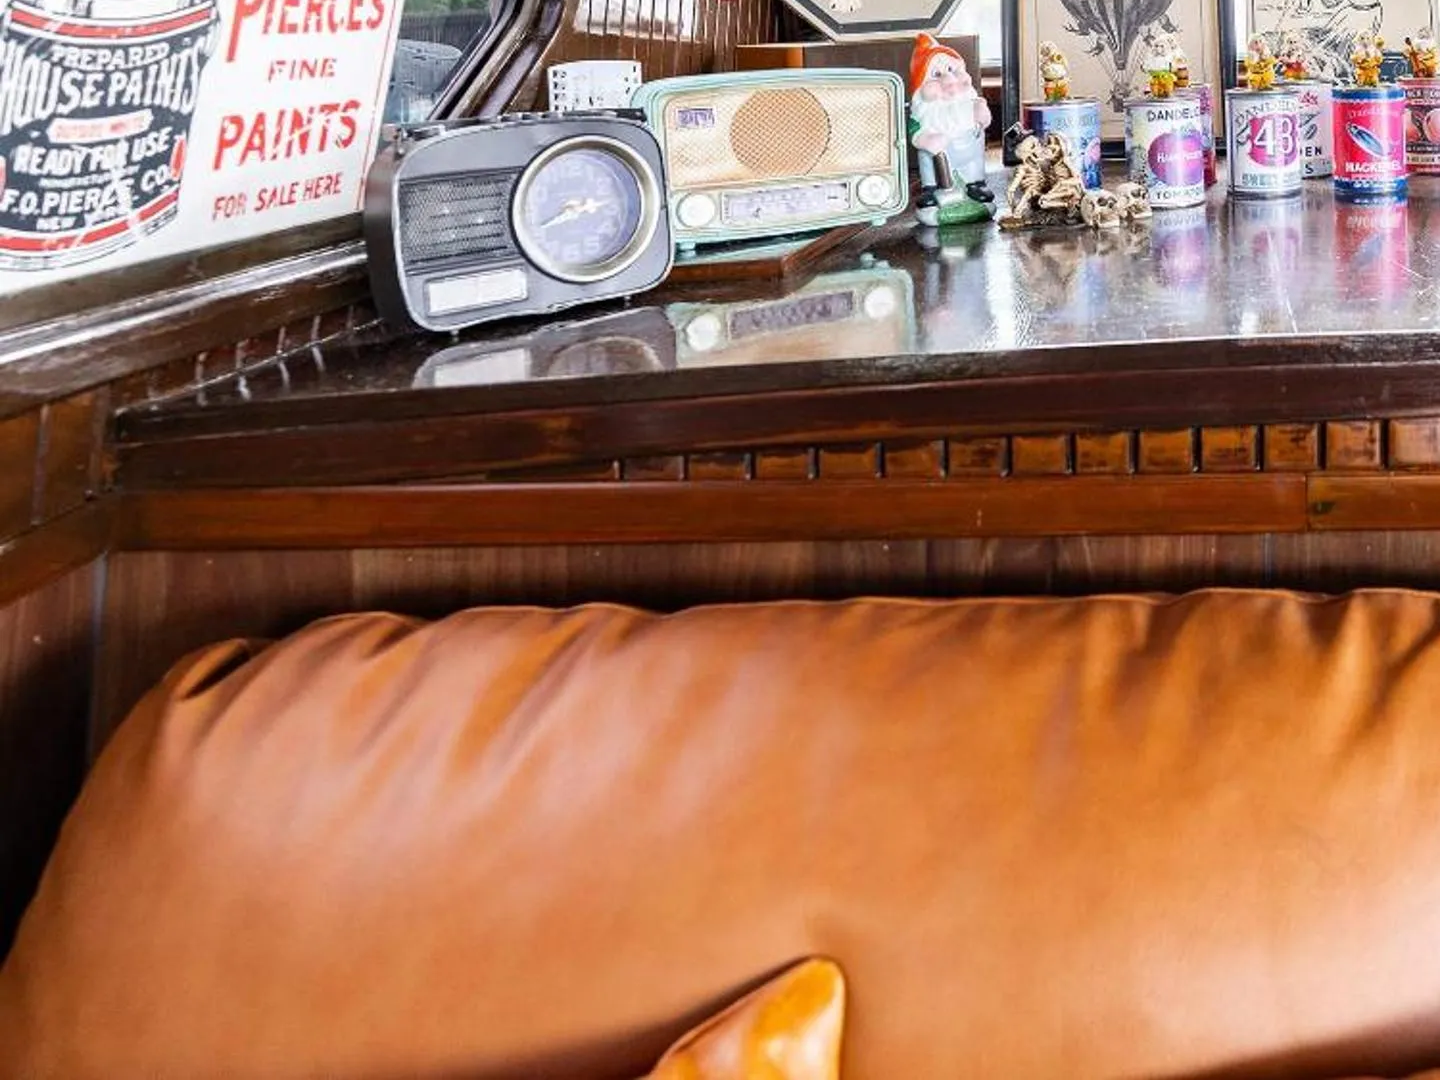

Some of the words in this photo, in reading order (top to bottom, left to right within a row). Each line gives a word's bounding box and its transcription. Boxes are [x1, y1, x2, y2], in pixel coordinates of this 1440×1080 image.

[51, 42, 171, 71] PREPARED
[267, 57, 337, 83] FINE
[13, 142, 90, 176] READY
[131, 126, 173, 162] USE
[212, 99, 363, 172] PAINTS
[212, 194, 246, 221] FOR
[254, 182, 299, 212] SALE
[302, 172, 344, 202] HERE
